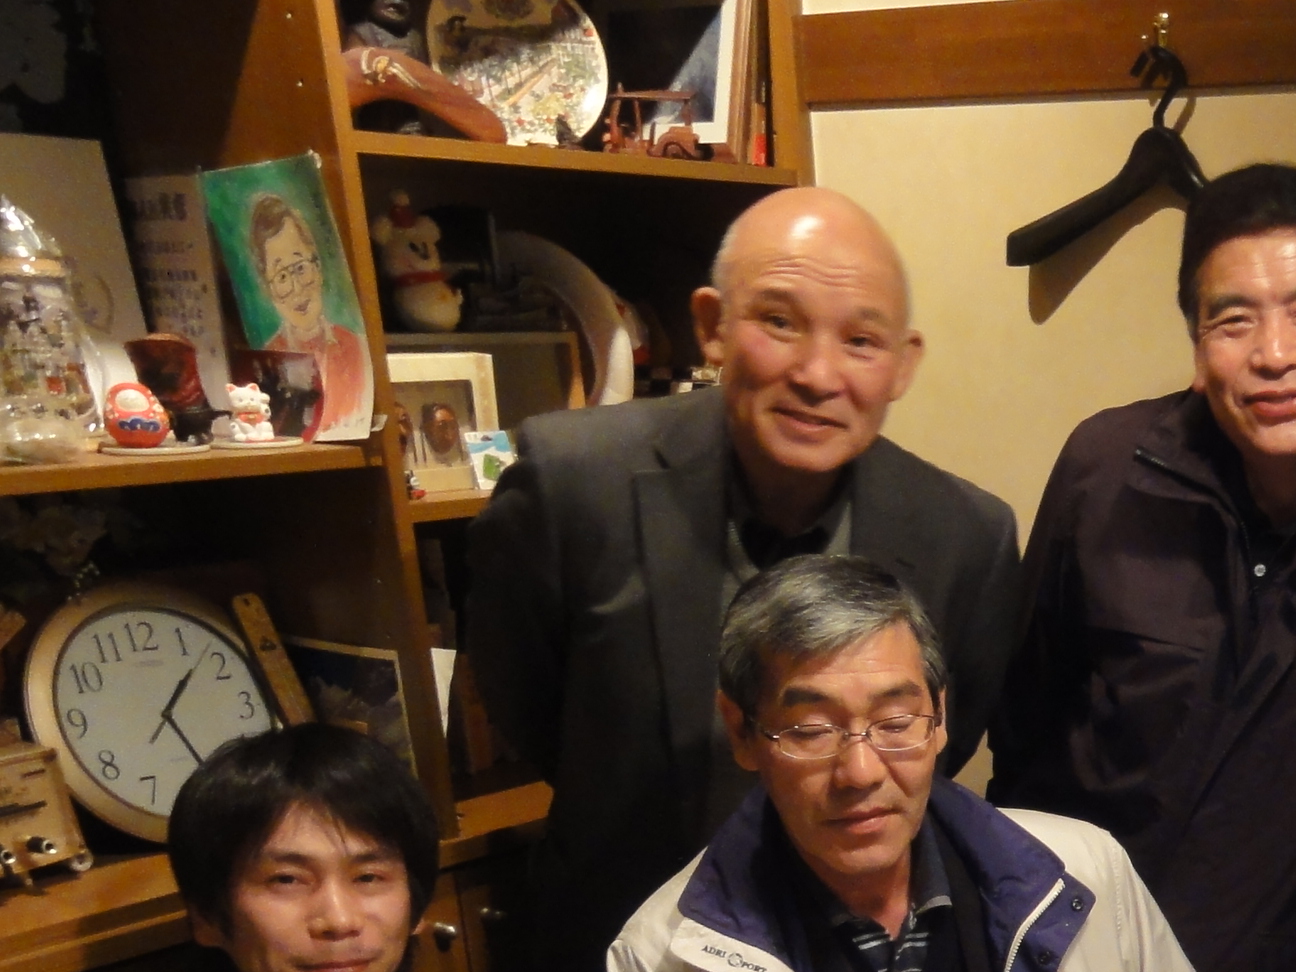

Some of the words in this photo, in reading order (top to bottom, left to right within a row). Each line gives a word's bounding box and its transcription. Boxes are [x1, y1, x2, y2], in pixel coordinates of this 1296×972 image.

[92, 632, 124, 664] 11
[124, 621, 160, 653] 12
[174, 627, 190, 656] 1
[69, 661, 103, 695] 10
[210, 652, 233, 682] 2
[237, 691, 256, 720] 3
[67, 708, 88, 739] 9
[98, 749, 121, 781] 8
[139, 775, 158, 806] 7
[702, 945, 727, 959] ADRI
